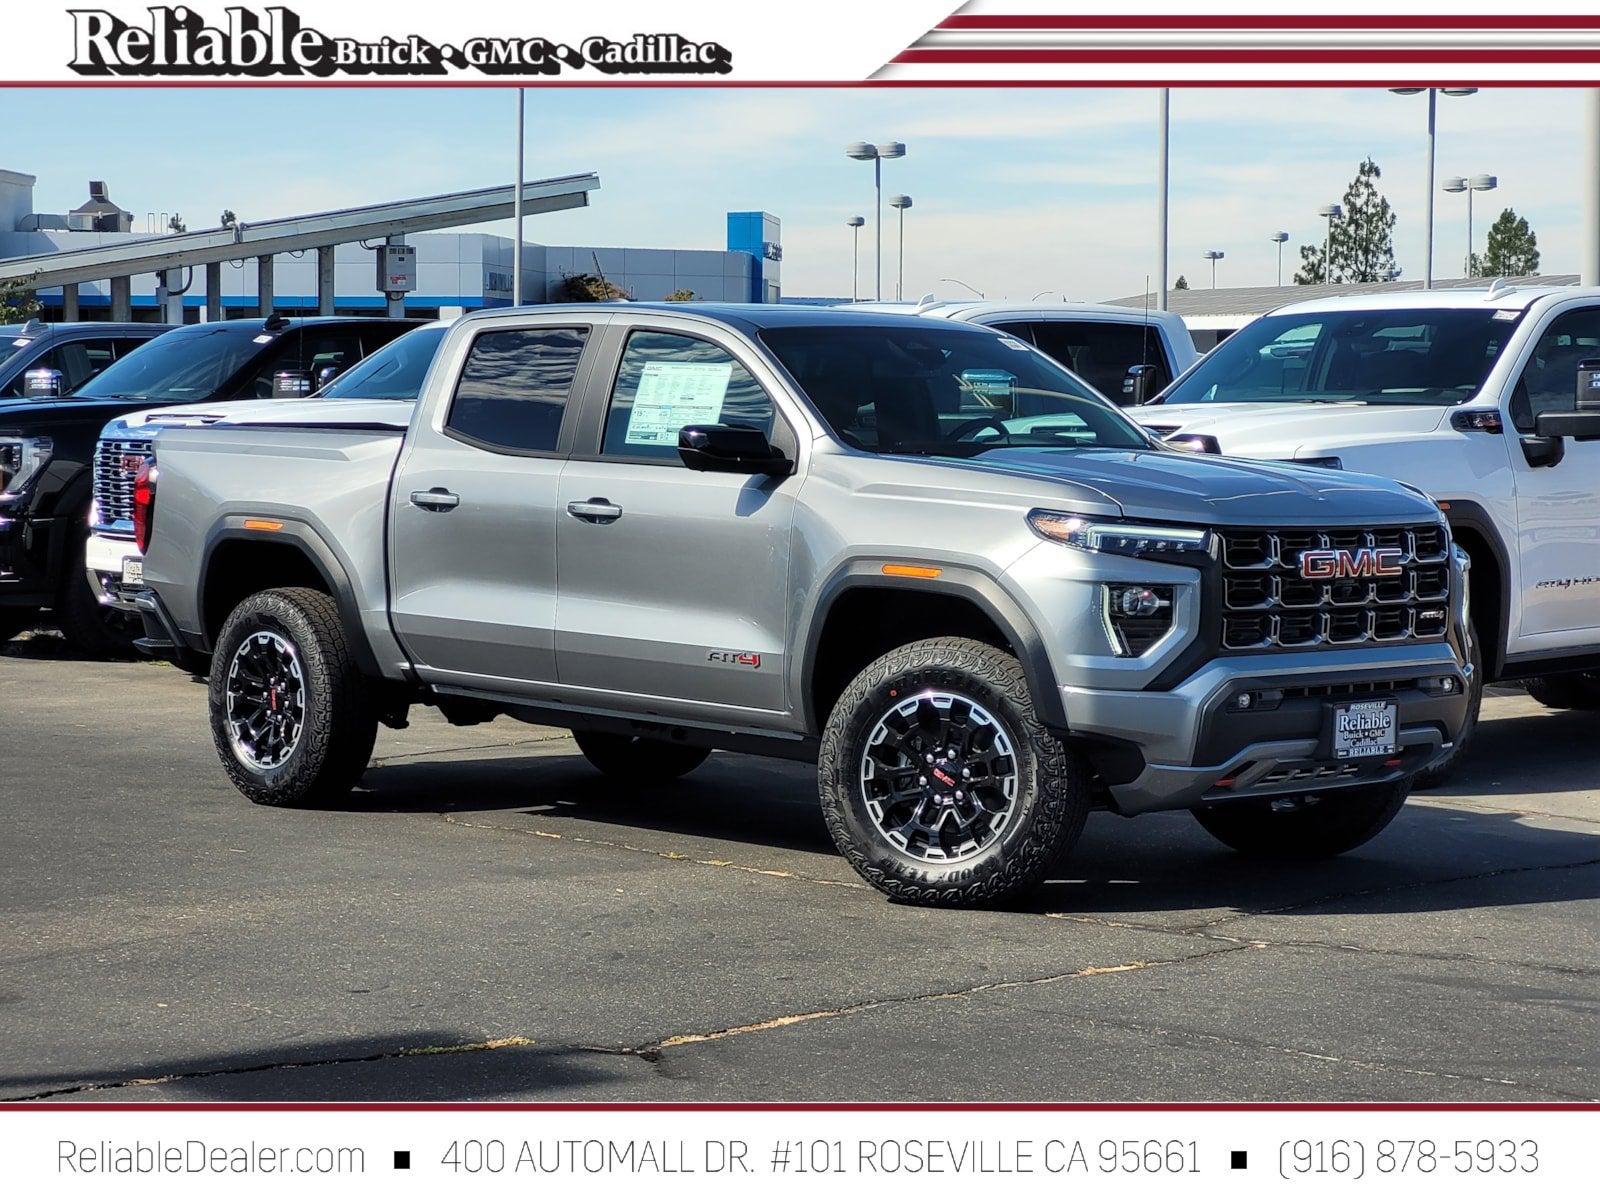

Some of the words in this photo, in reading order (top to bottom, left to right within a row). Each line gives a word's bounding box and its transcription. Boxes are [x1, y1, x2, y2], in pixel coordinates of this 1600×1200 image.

[1301, 548, 1403, 579] GMC
[1350, 701, 1386, 711] ROSEVILLE
[1339, 711, 1391, 732] Reliable
[1343, 730, 1364, 740] Buick
[1369, 728, 1386, 738] GMC
[1350, 737, 1379, 748] Cadillac
[1349, 746, 1385, 756] RELIABLE
